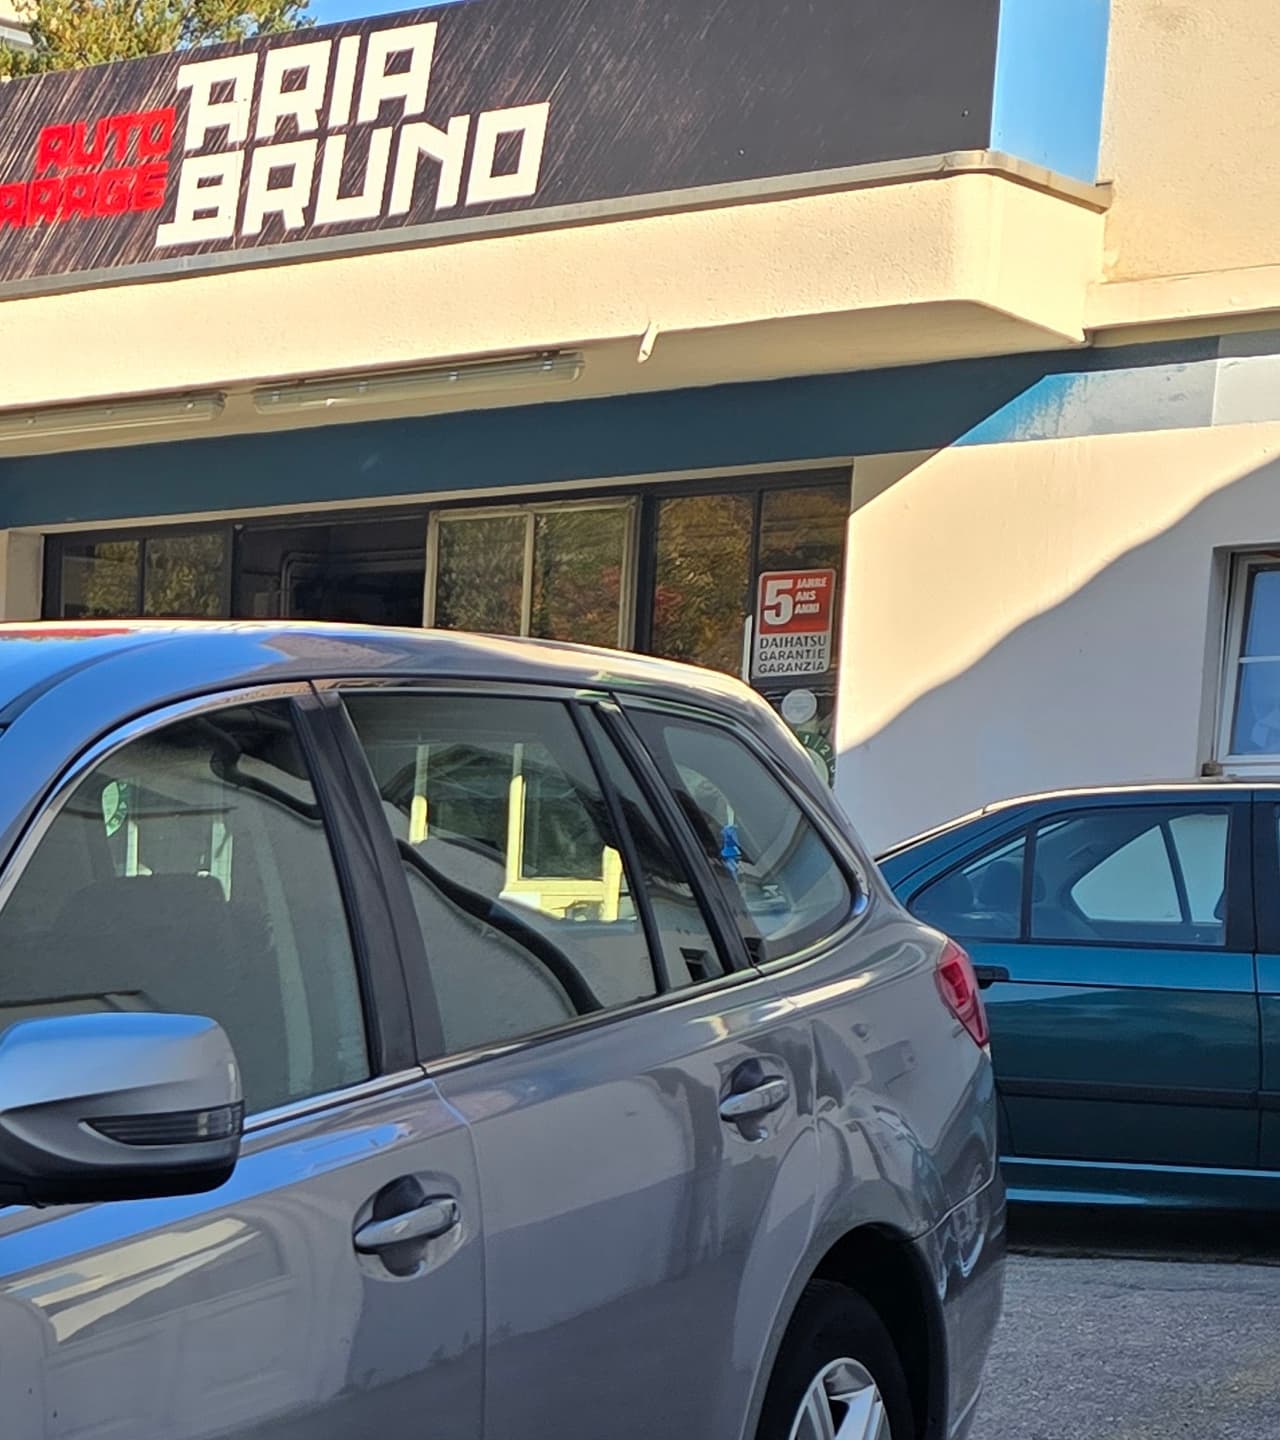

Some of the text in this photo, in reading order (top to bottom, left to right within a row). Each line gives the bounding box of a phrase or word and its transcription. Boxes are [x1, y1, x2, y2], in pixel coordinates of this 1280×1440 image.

[177, 21, 438, 152] ARIA
[36, 107, 175, 172] AUTO
[156, 102, 551, 248] BRUNO
[764, 579, 794, 625] 5
[759, 648, 825, 662] GARANTIE
[760, 634, 827, 649] DAIHATSU
[758, 661, 825, 674] GARANZIA
